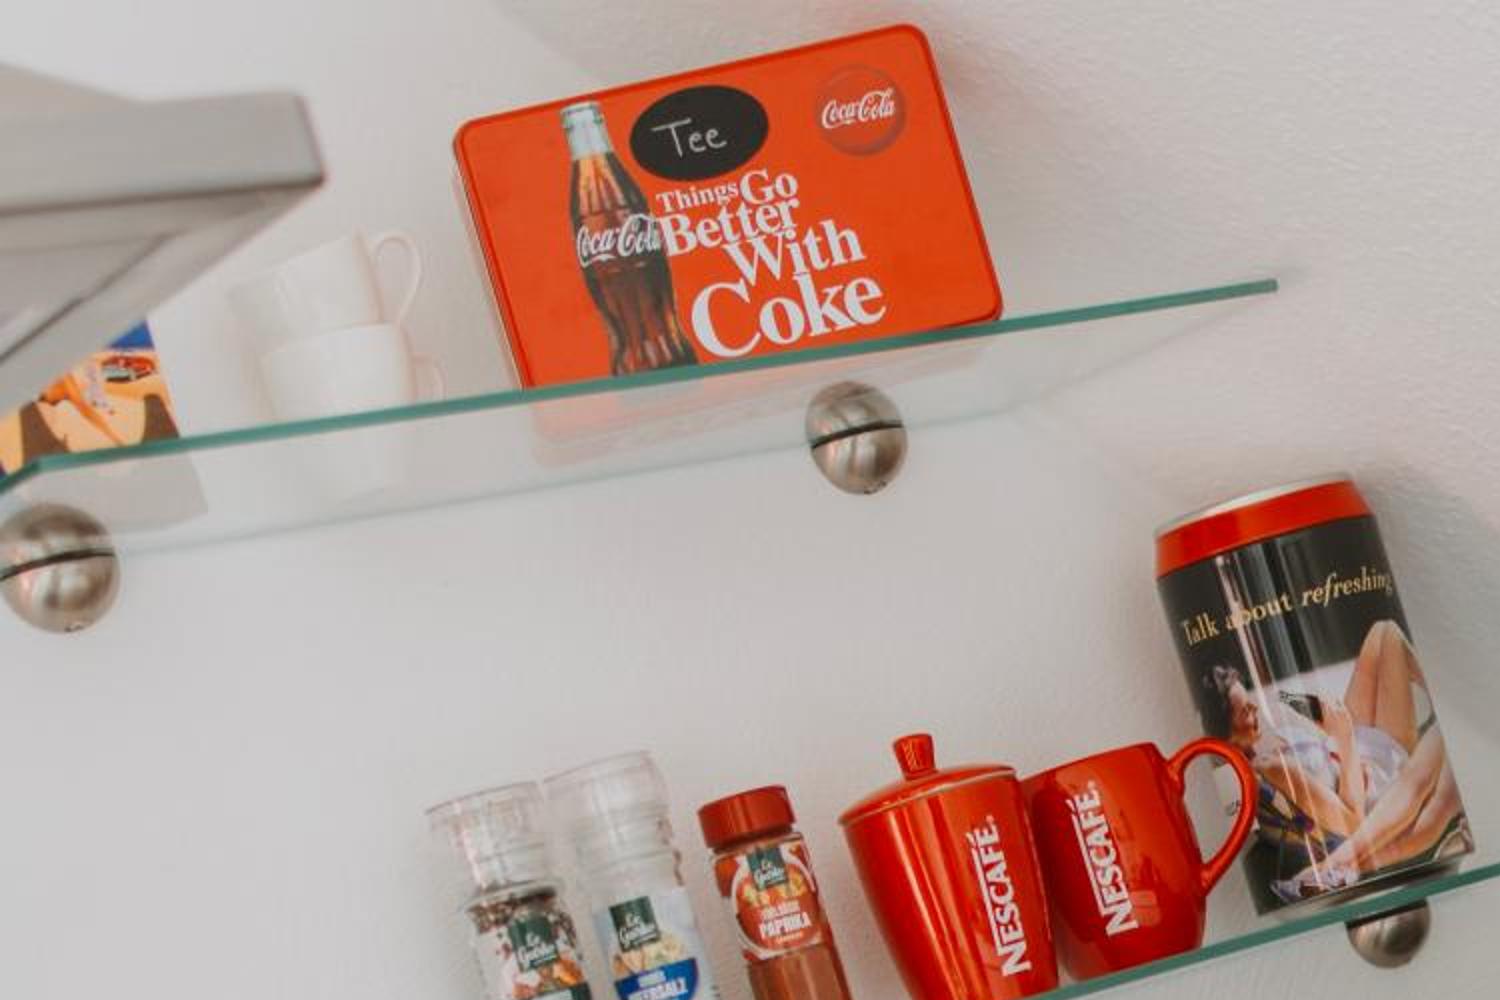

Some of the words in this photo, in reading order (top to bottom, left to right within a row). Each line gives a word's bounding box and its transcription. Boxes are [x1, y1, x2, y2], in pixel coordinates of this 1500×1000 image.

[652, 118, 729, 159] Tee
[656, 182, 739, 212] Things
[740, 169, 798, 204] Go
[657, 199, 799, 256] Better
[722, 218, 866, 287] With
[691, 273, 887, 358] Coke
